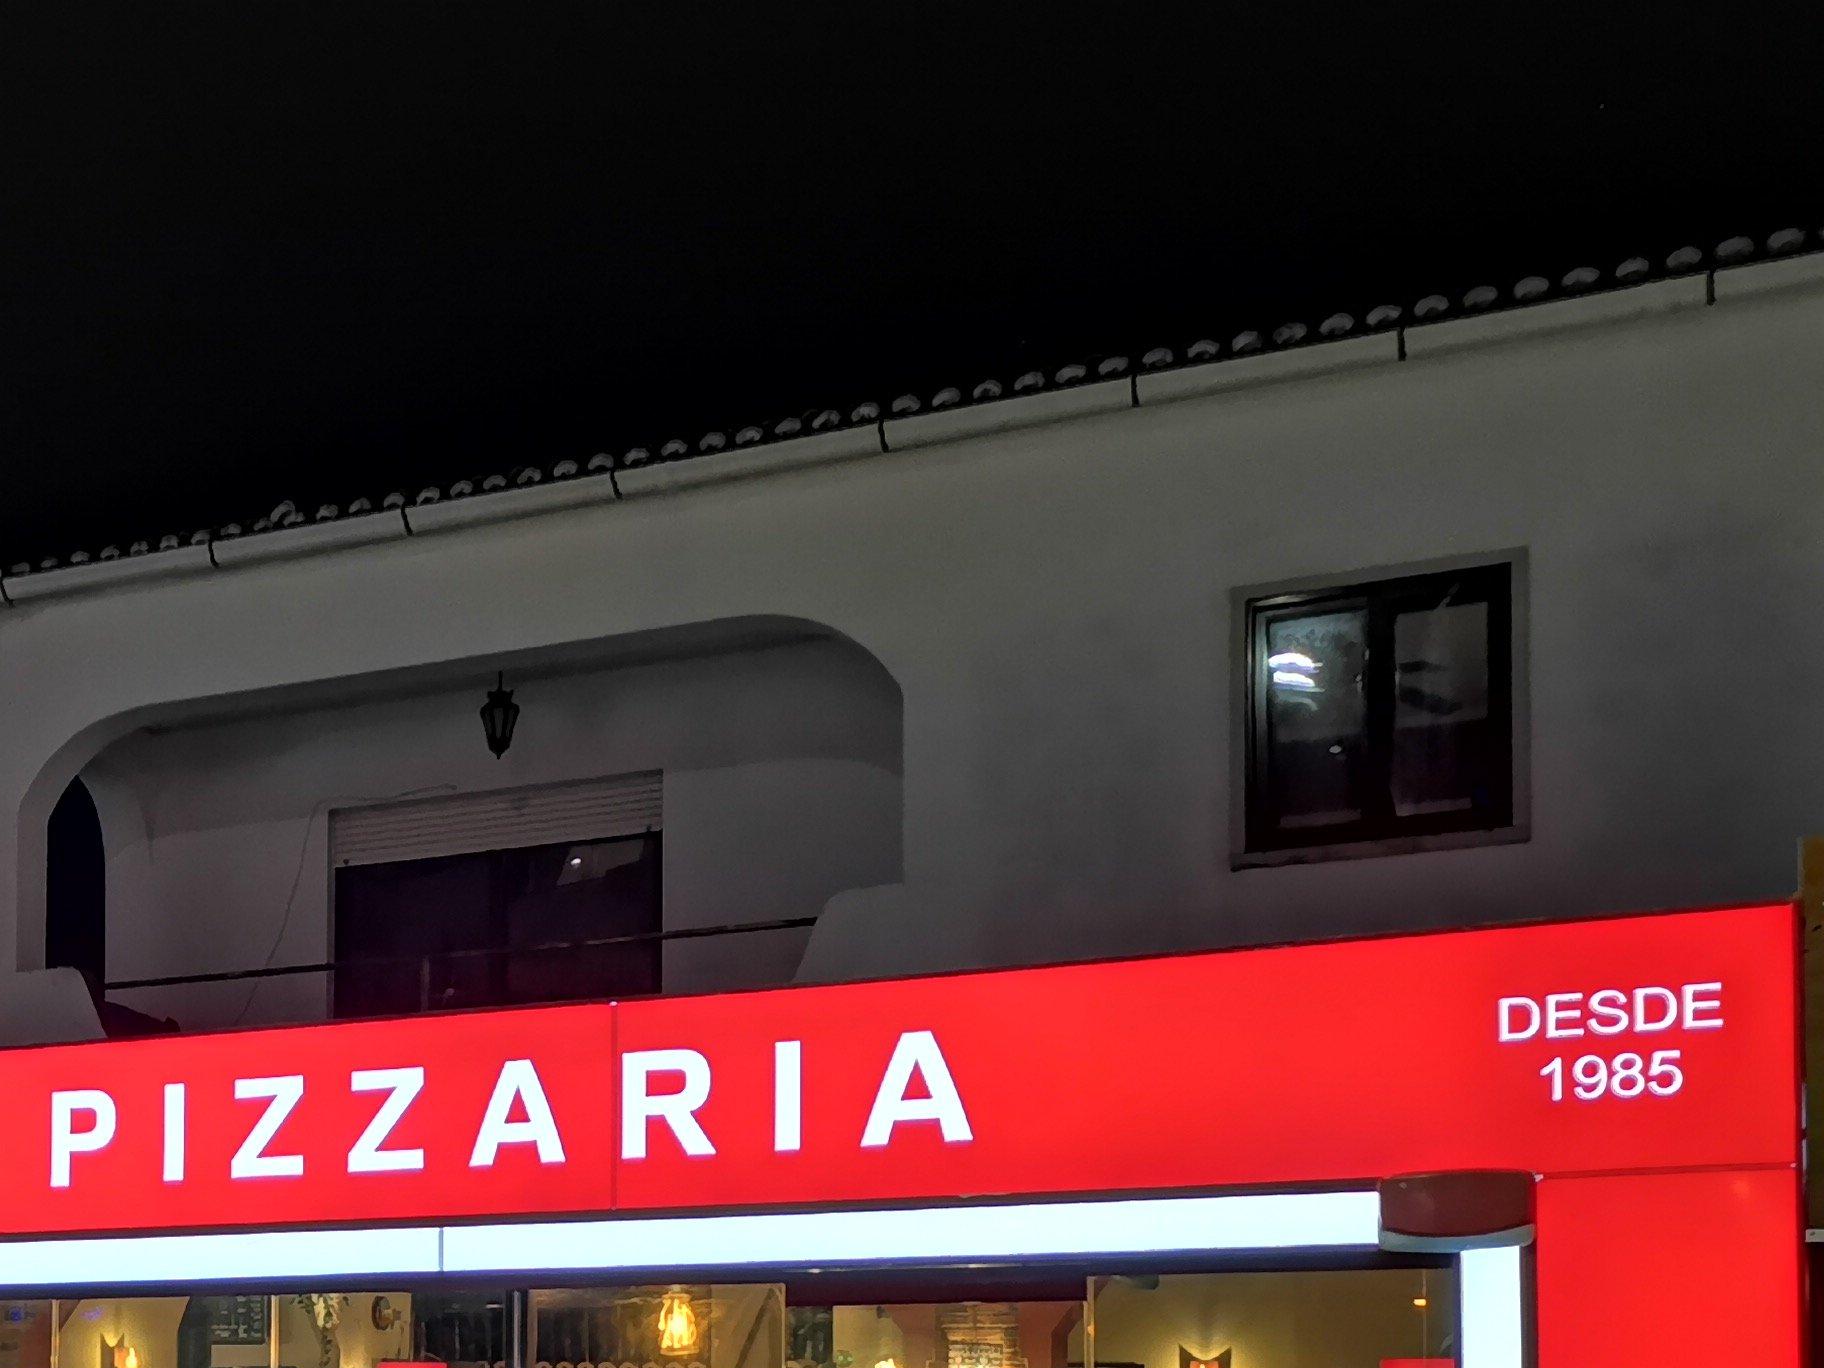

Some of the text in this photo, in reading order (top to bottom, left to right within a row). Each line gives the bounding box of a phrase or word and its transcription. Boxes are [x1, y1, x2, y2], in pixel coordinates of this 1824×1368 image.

[1497, 981, 1724, 1043] DESDE
[1539, 1049, 1684, 1102] 1985
[49, 1030, 974, 1188] PIZZARIA
